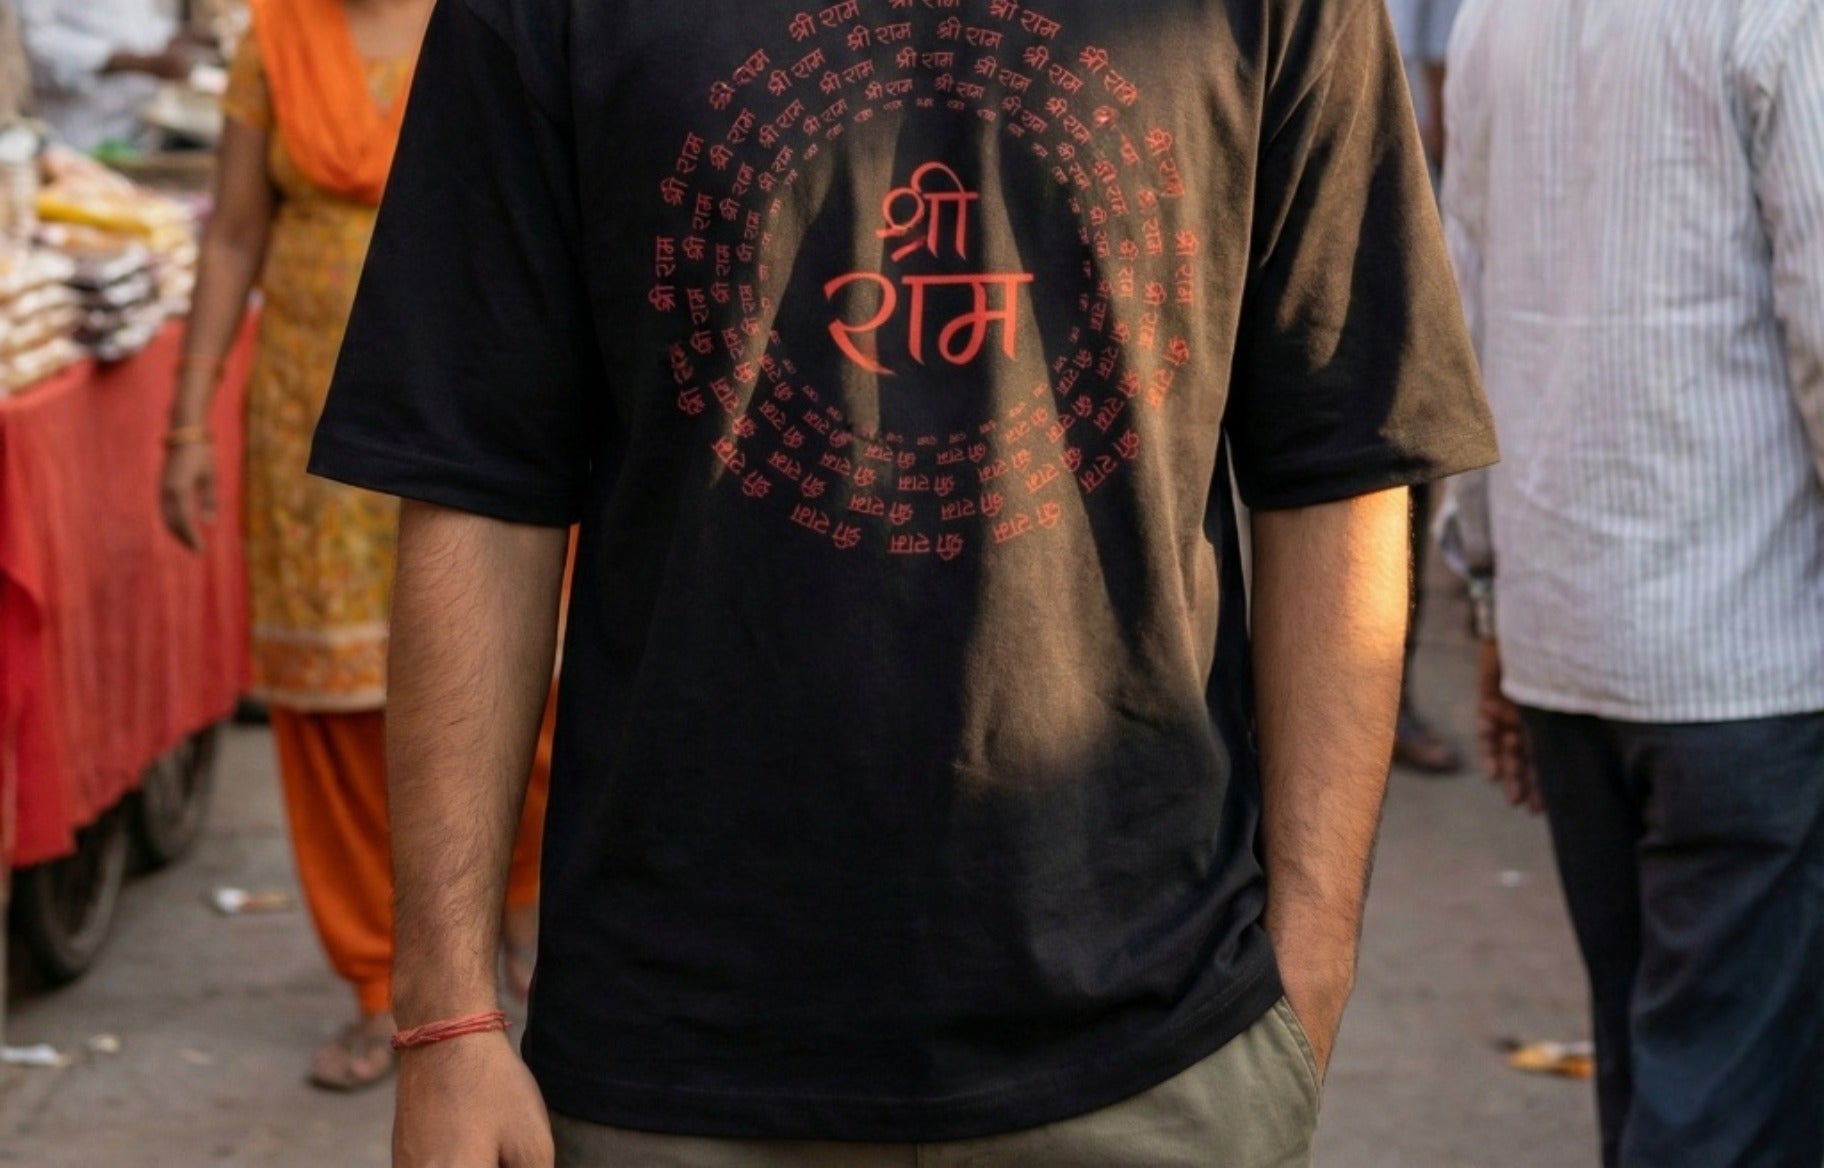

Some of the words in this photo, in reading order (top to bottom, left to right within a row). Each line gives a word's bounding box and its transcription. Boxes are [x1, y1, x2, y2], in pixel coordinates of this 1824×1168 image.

[788, 9, 817, 41] श्री
[846, 25, 870, 50] श्री
[876, 21, 912, 41] राम
[938, 16, 961, 39] श्री
[968, 27, 1003, 48] राम
[1021, 8, 1064, 38] राम
[768, 68, 791, 95] श्री
[793, 48, 824, 77] राम
[1025, 45, 1049, 69] श्री
[1047, 64, 1083, 92] राम
[1079, 42, 1109, 74] श्री
[709, 143, 733, 168] श्री
[728, 109, 755, 143] राम
[658, 175, 686, 206] श्री
[675, 131, 703, 173] राम
[693, 193, 711, 228] राम
[875, 161, 980, 262] श्री
[653, 234, 675, 277] राम
[645, 281, 676, 313] श्री
[1175, 263, 1197, 307] राम
[823, 272, 1034, 375] राम
[676, 389, 705, 417] श्री
[1115, 429, 1142, 461] श्री
[741, 472, 771, 500] श्री
[1080, 454, 1119, 493] राम
[790, 505, 831, 535] राम
[992, 514, 1032, 545] राम
[1037, 500, 1063, 527] श्री
[833, 524, 861, 550] श्री
[887, 534, 931, 557] राम
[935, 533, 965, 561] श्री
